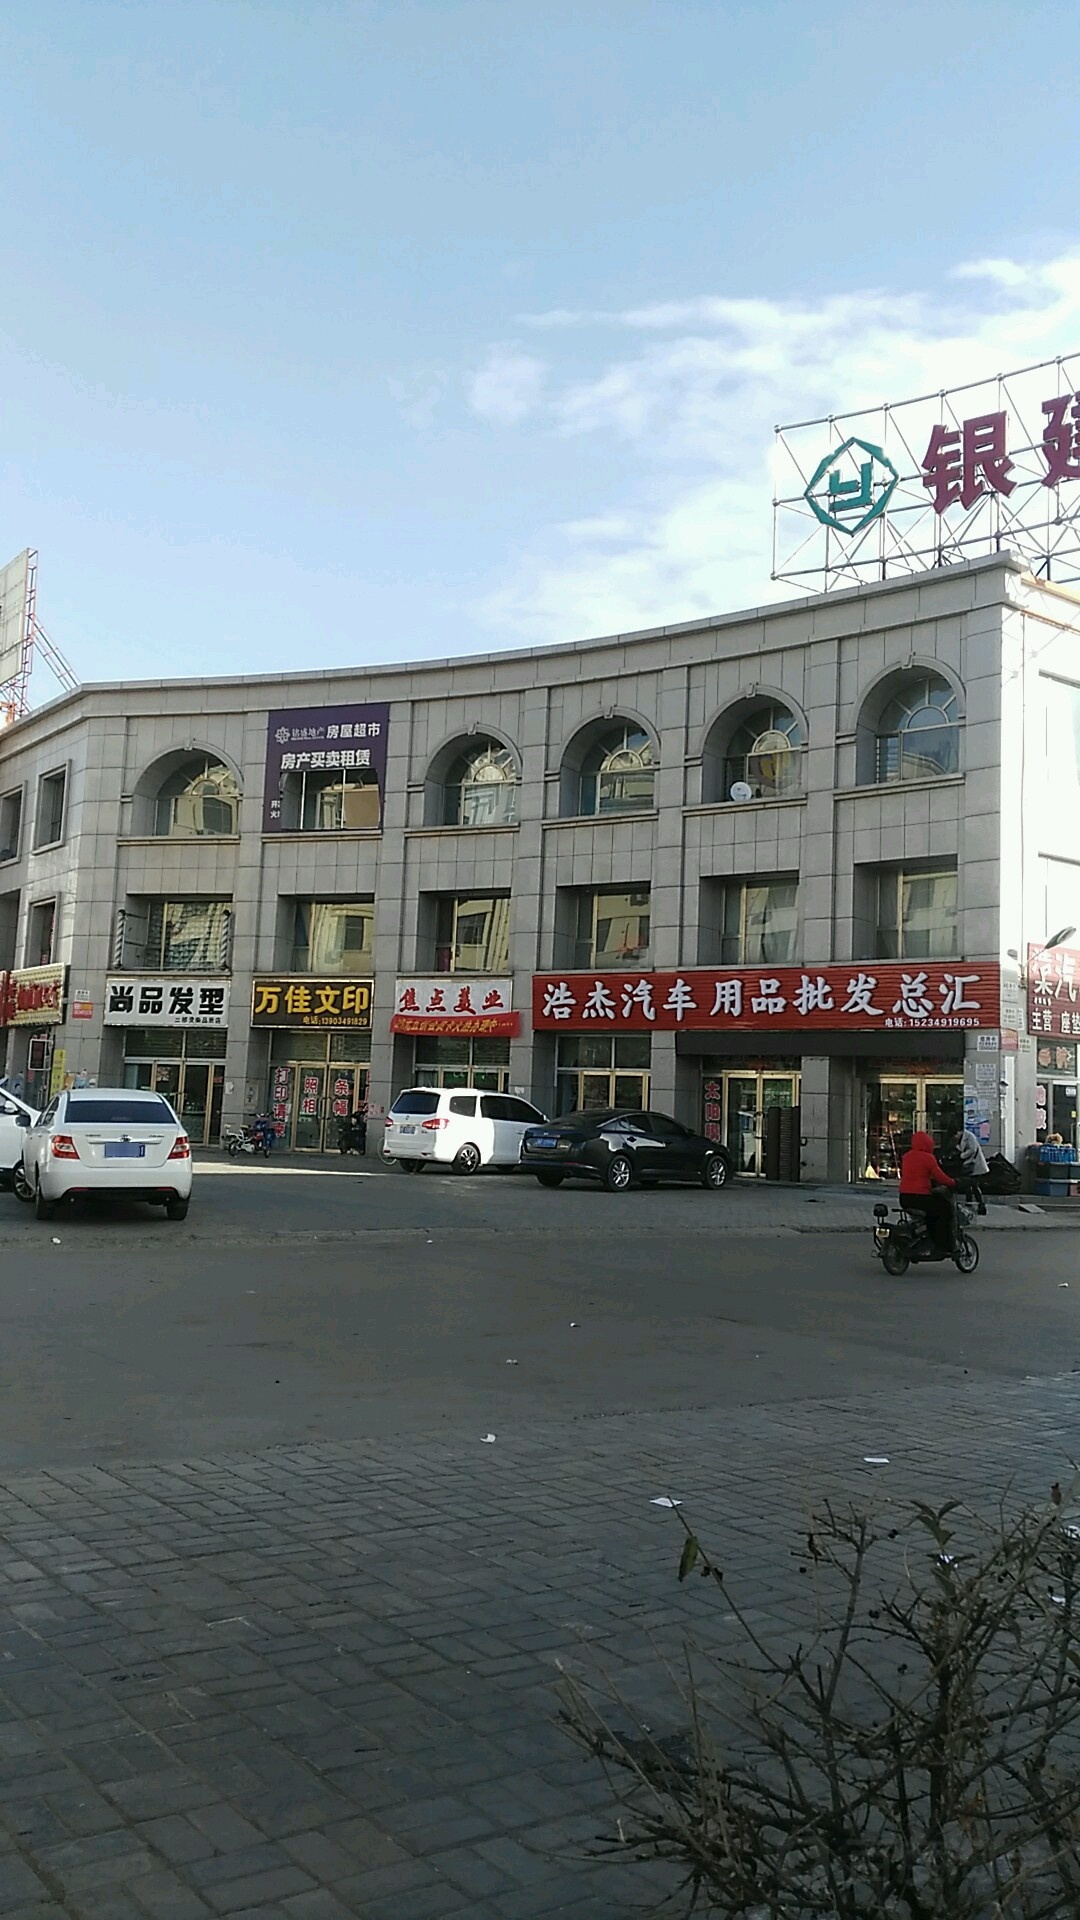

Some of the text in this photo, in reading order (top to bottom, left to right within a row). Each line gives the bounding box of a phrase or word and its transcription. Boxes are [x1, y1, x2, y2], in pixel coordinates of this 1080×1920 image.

[326, 723, 380, 739] 房屋超市
[281, 749, 370, 769] 房产买卖租赁
[109, 986, 224, 1015] 尚品发型
[255, 985, 369, 1014] 万佳文印
[399, 986, 504, 1015] 焦点美业
[542, 972, 981, 1021] 浩杰汽车用品批发总汇
[1032, 1008, 1052, 1032] 主营
[273, 1067, 290, 1138] 打印请柬
[303, 1077, 318, 1115] 照相
[333, 1079, 349, 1116] 条幅
